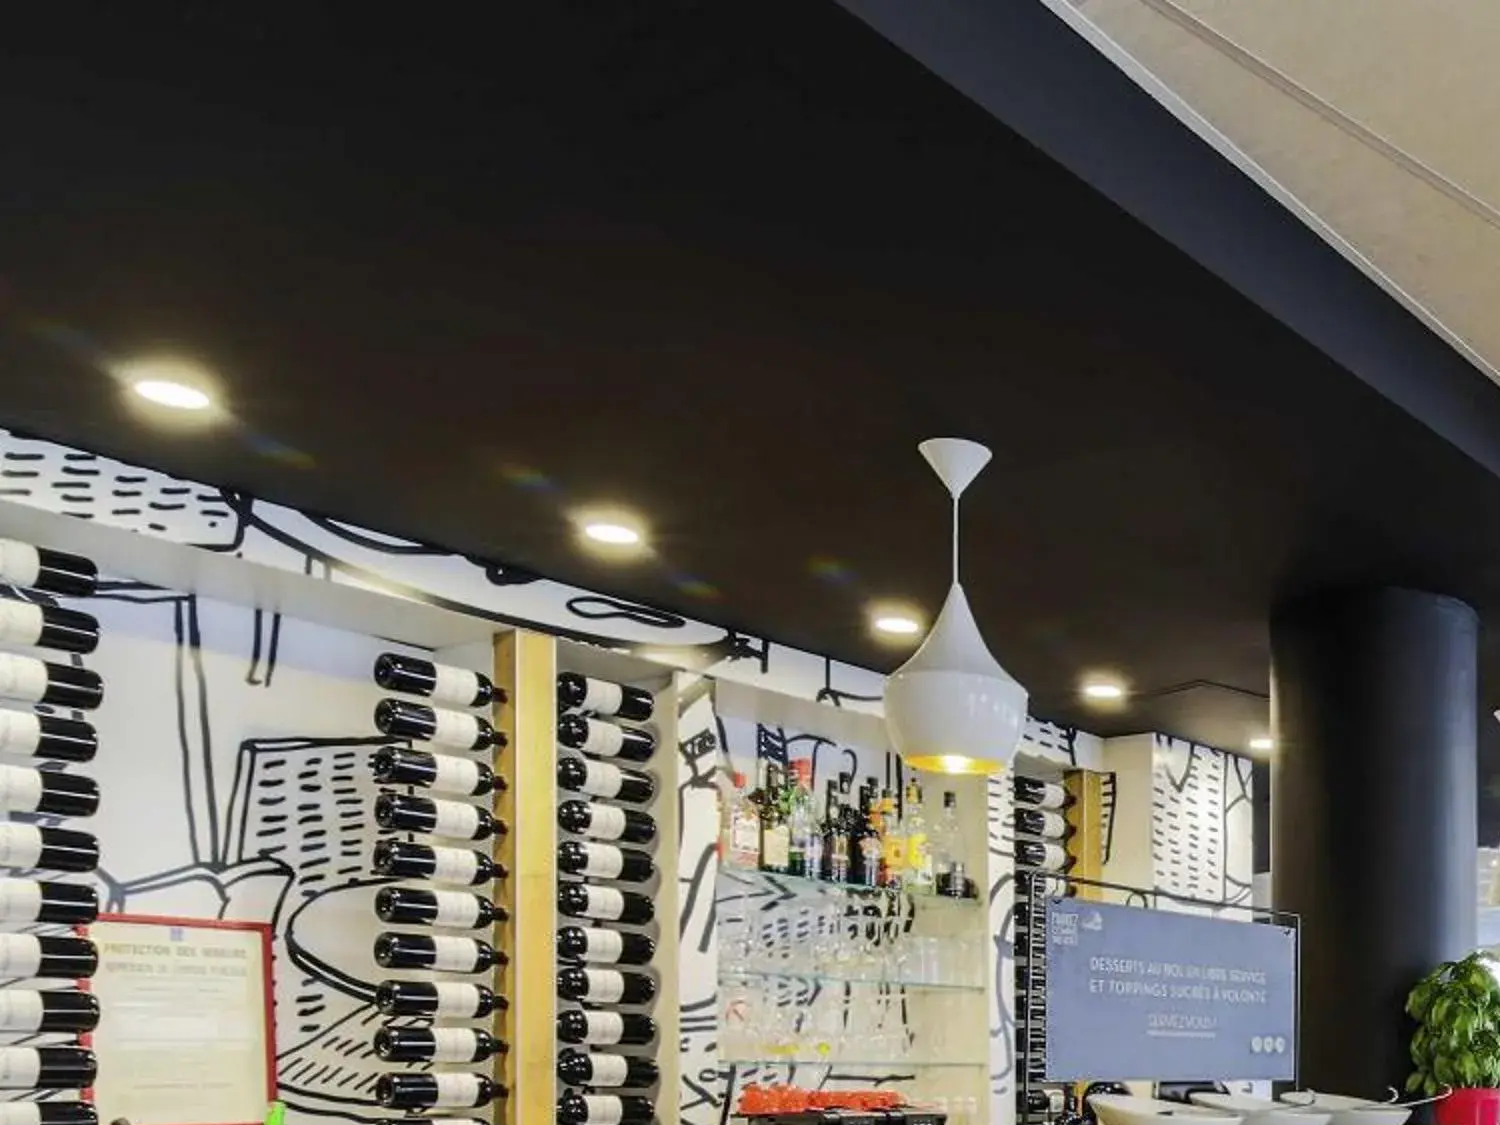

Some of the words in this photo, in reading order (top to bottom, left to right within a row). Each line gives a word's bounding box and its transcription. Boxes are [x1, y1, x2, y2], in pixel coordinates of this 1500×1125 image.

[1089, 956, 1145, 977] DESSERTS
[1089, 979, 1105, 994] ET
[1108, 980, 1168, 998] TOPPINGS
